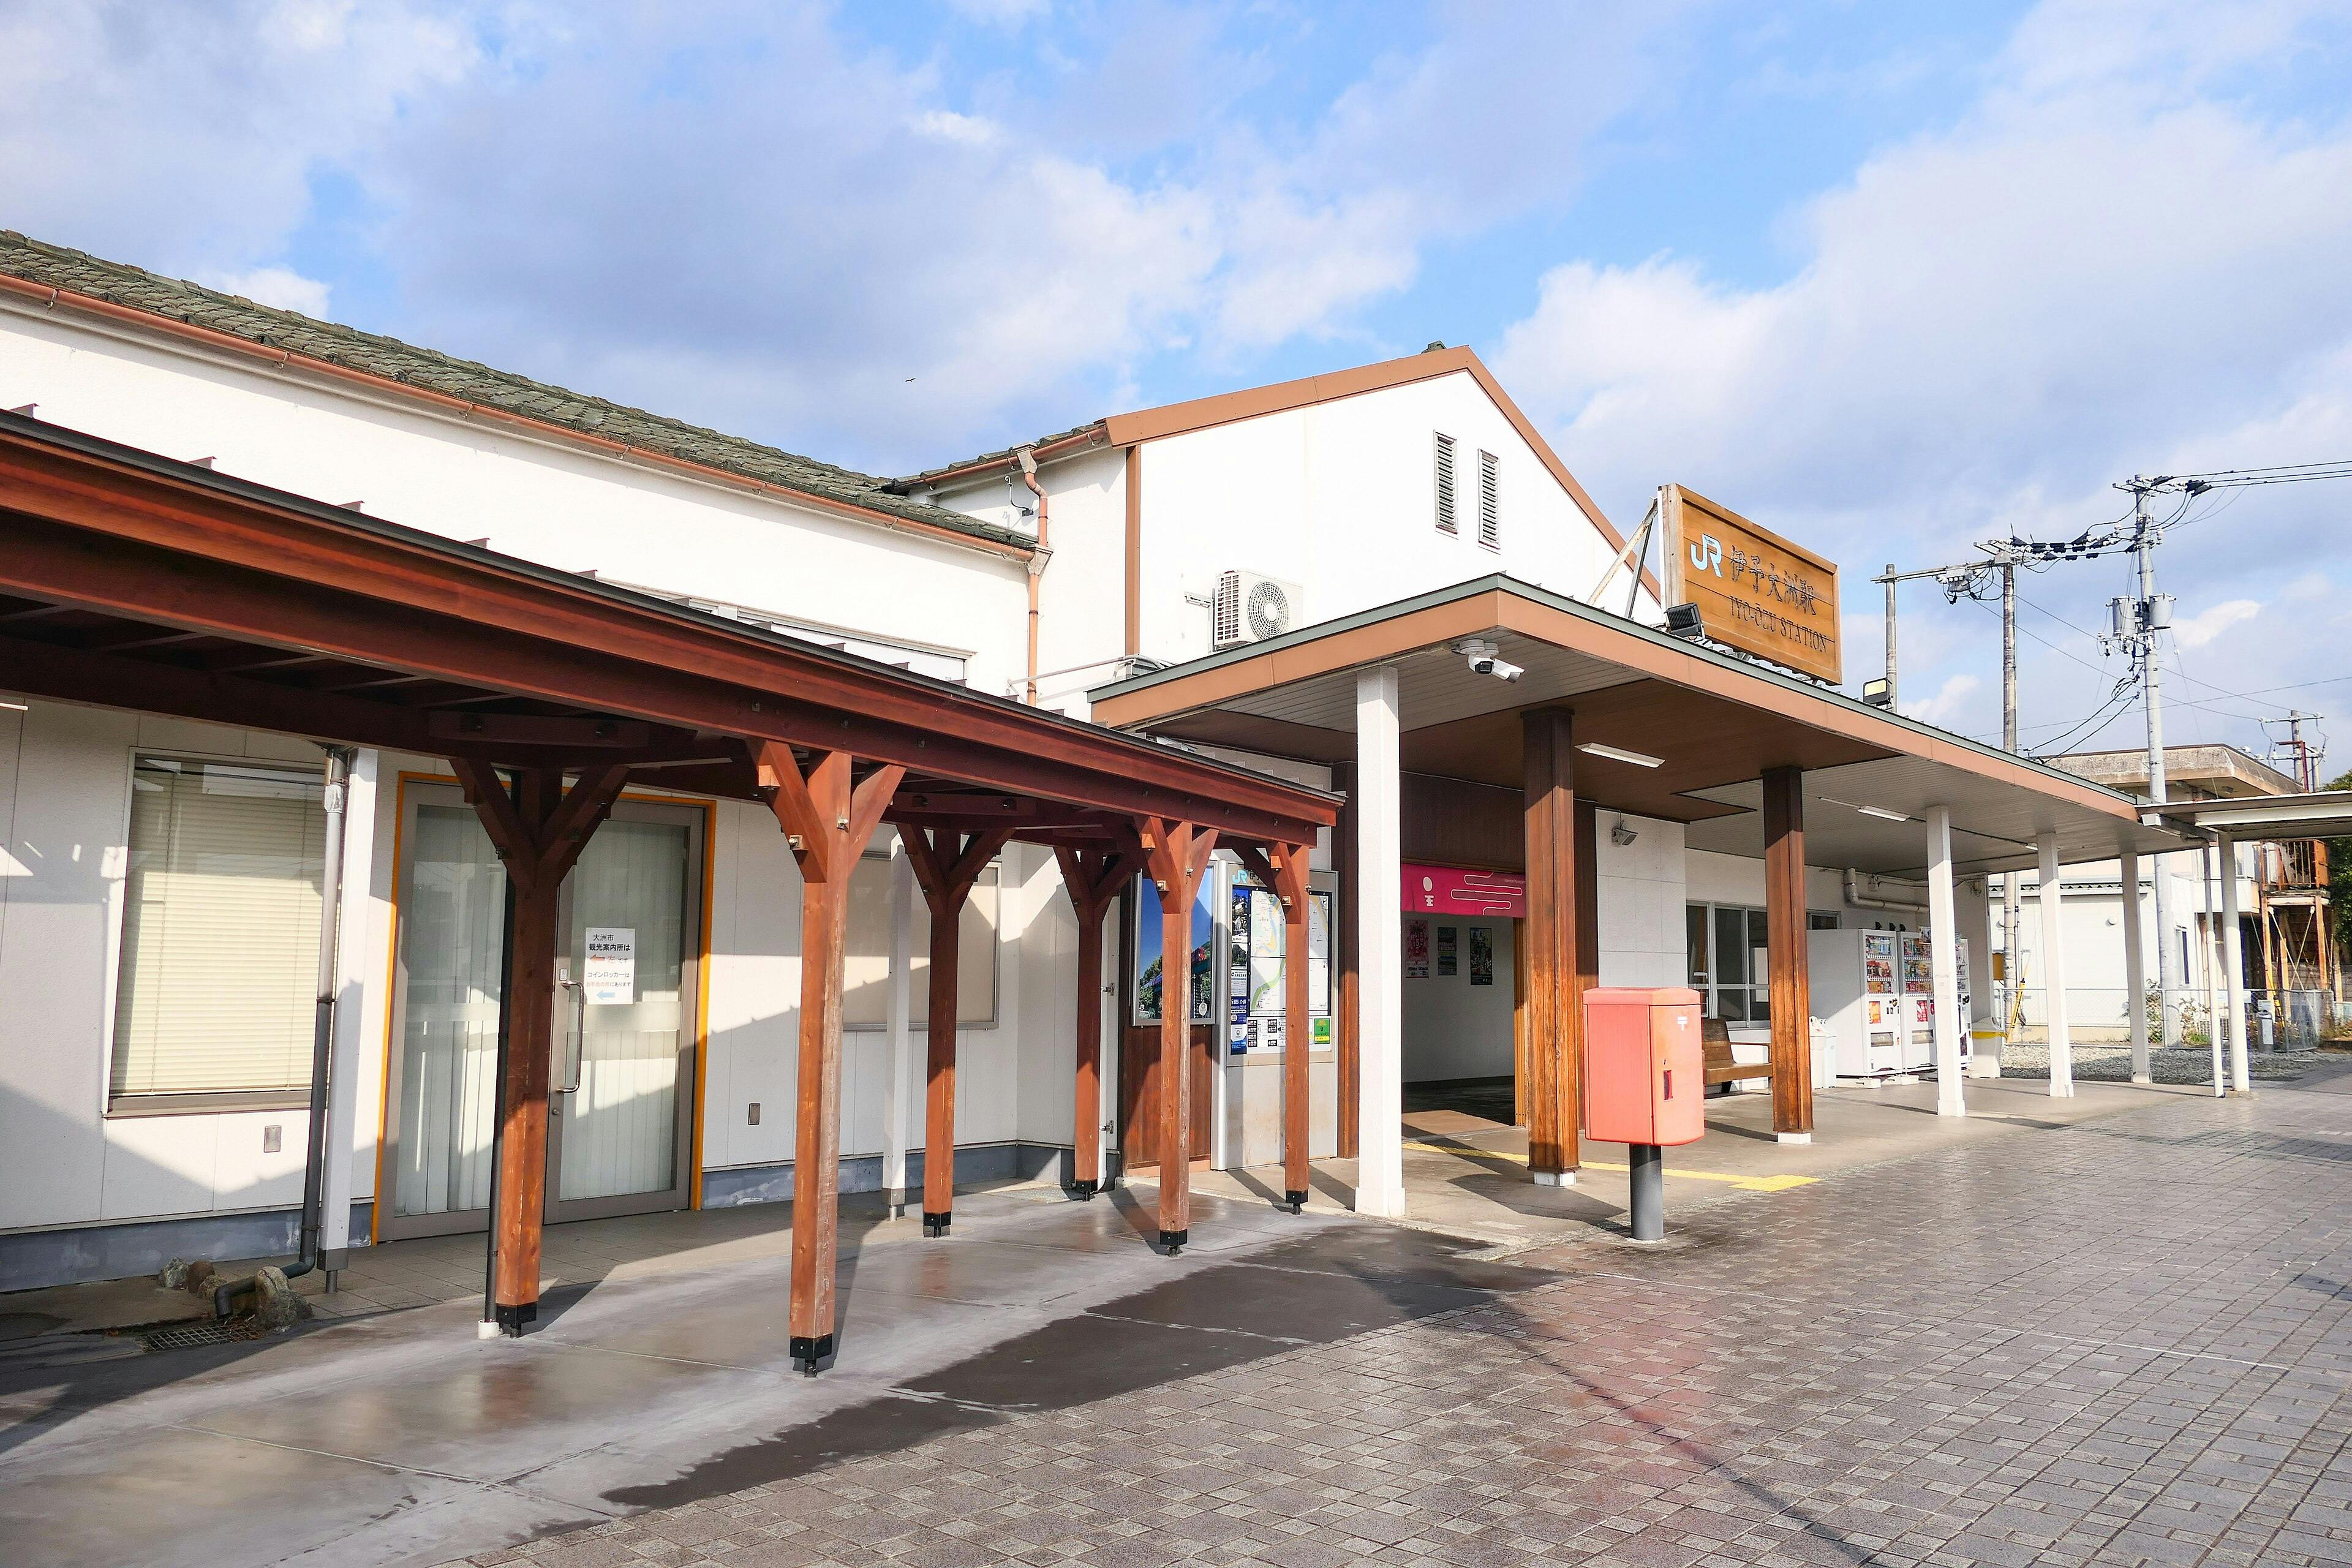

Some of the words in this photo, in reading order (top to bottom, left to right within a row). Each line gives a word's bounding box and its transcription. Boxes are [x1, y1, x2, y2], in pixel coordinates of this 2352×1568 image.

[1691, 533, 1722, 578] JR
[1730, 545, 1816, 615] 伊予大洲駅
[1781, 617, 1826, 652] STATION
[1232, 870, 1247, 883] JR
[608, 956, 616, 964] 左
